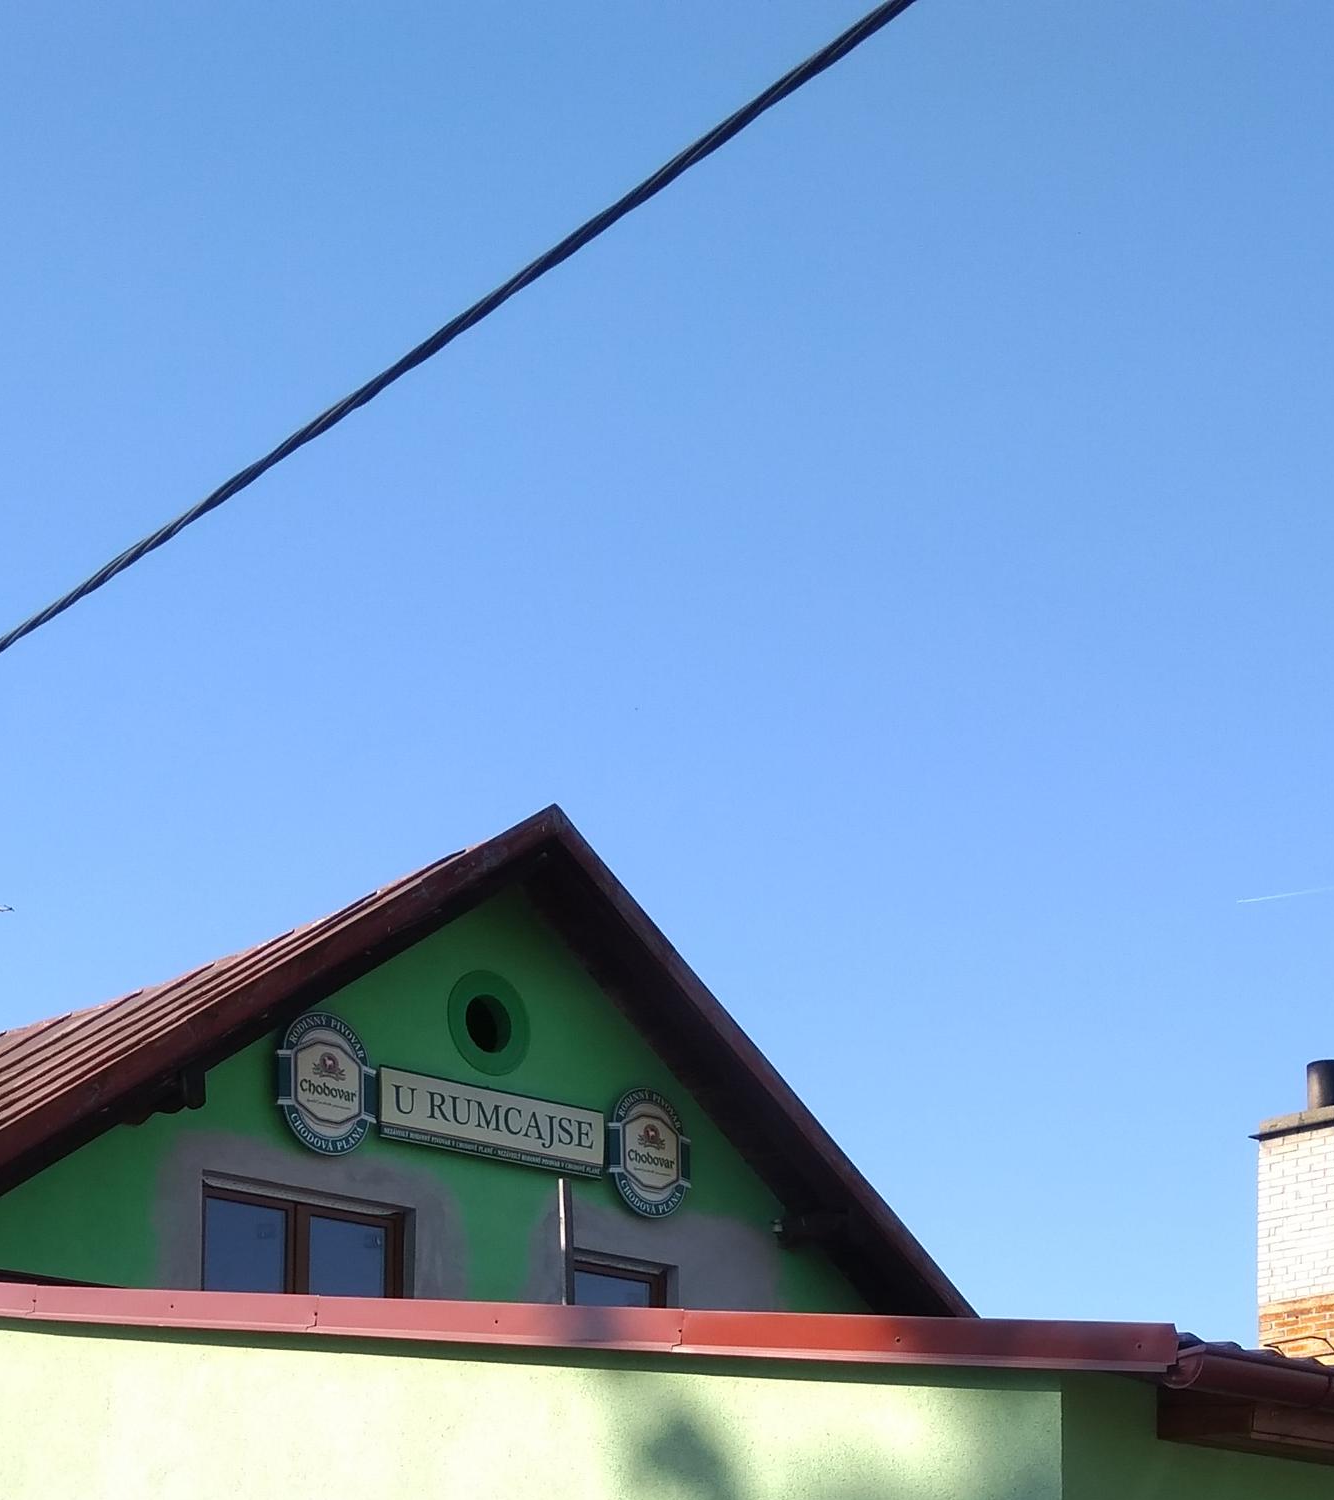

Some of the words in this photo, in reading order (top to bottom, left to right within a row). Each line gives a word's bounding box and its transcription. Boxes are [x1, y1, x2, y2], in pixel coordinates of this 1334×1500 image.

[288, 1015, 328, 1044] RODINNÝ
[330, 1018, 365, 1058] PIVOVAR
[291, 1113, 333, 1151] CHODOVÁ
[391, 1083, 417, 1115] U
[426, 1090, 594, 1149] RUMCAJSE
